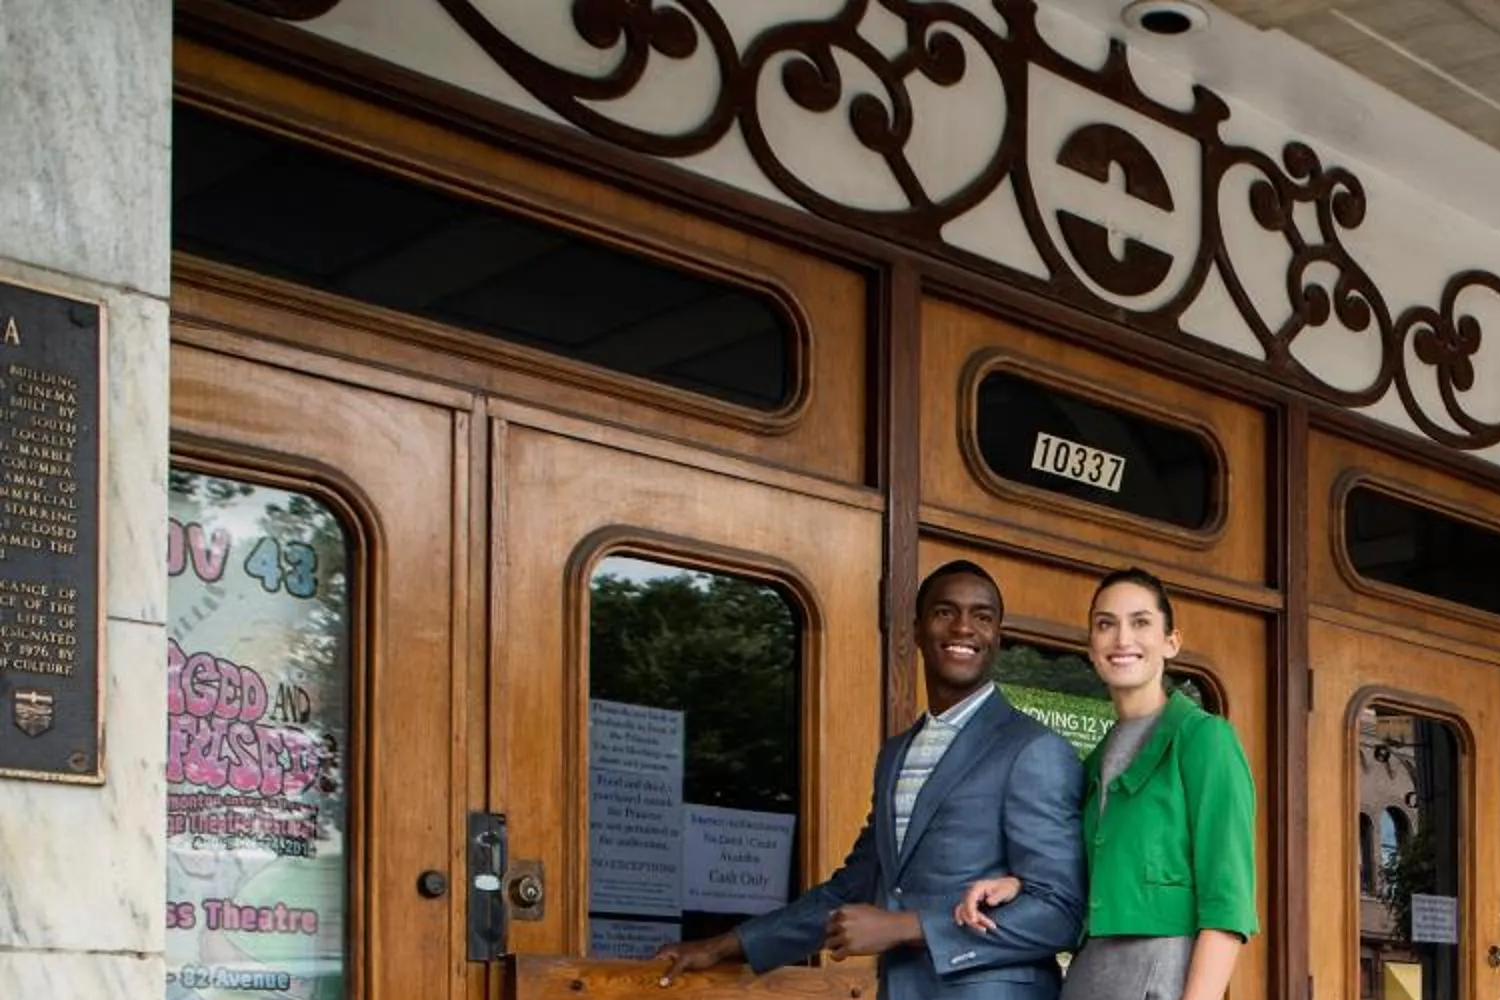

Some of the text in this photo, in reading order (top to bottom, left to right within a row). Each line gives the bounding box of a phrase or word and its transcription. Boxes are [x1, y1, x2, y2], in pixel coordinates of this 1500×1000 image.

[17, 382, 77, 405] CINEMA
[59, 404, 76, 419] BY
[32, 415, 77, 435] SOUTH
[12, 426, 77, 449] LOCALLY
[1040, 436, 1123, 488] 10337
[59, 480, 77, 494] OF
[21, 520, 78, 540] CLOSED
[49, 540, 76, 556] THE
[243, 536, 319, 599] 43
[59, 587, 77, 600] OF
[24, 598, 42, 611] OF
[50, 600, 76, 615] THE
[17, 611, 77, 630] LIFE OF
[19, 643, 49, 657] 1976
[58, 648, 75, 661] BY
[12, 658, 73, 677] CULTURE
[270, 682, 311, 724] AND
[1081, 715, 1097, 734] 12
[708, 868, 738, 885] Cash
[201, 897, 319, 936] Theatre
[180, 964, 212, 989] 82
[213, 966, 291, 991] Avenue
